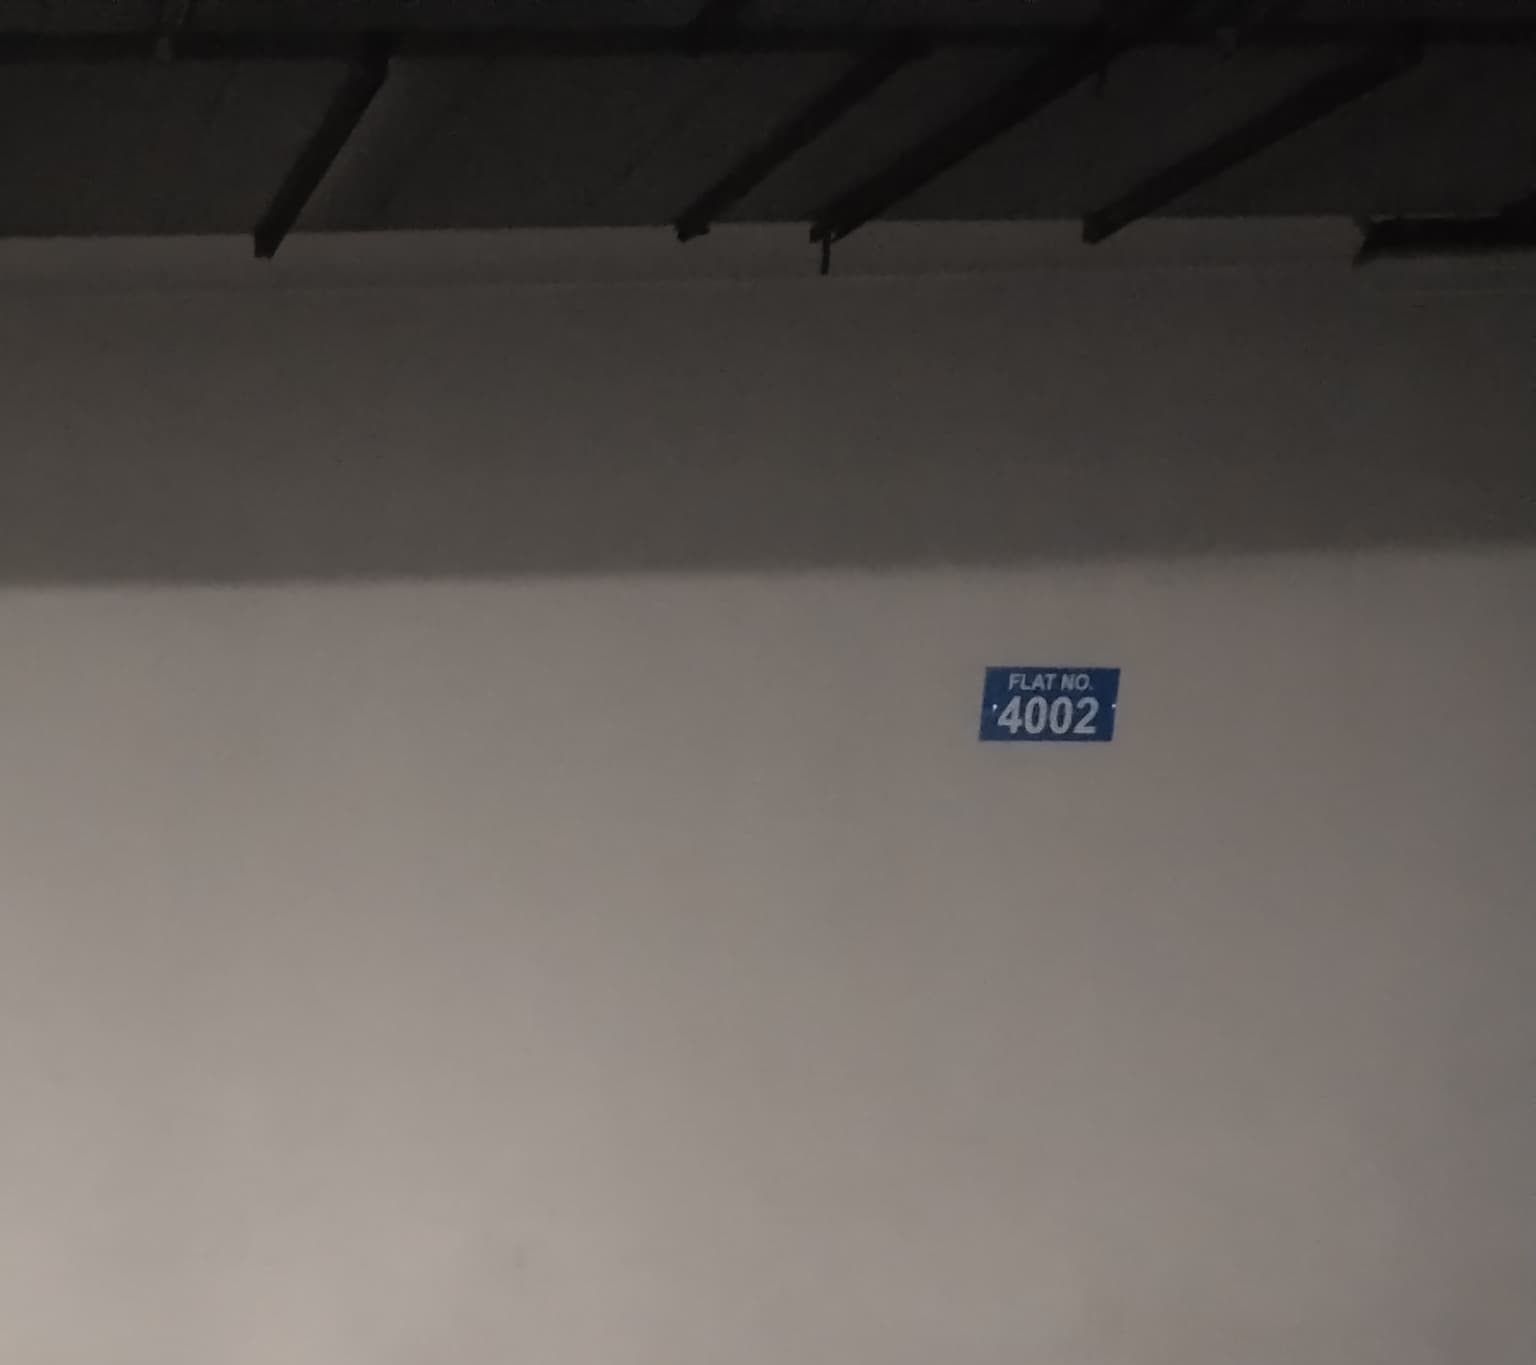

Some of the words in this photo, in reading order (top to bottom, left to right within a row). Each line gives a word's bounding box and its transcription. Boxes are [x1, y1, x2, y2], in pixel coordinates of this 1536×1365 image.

[1008, 673, 1056, 691] FLAT
[1061, 673, 1094, 691] NO.
[997, 695, 1099, 734] 4002
